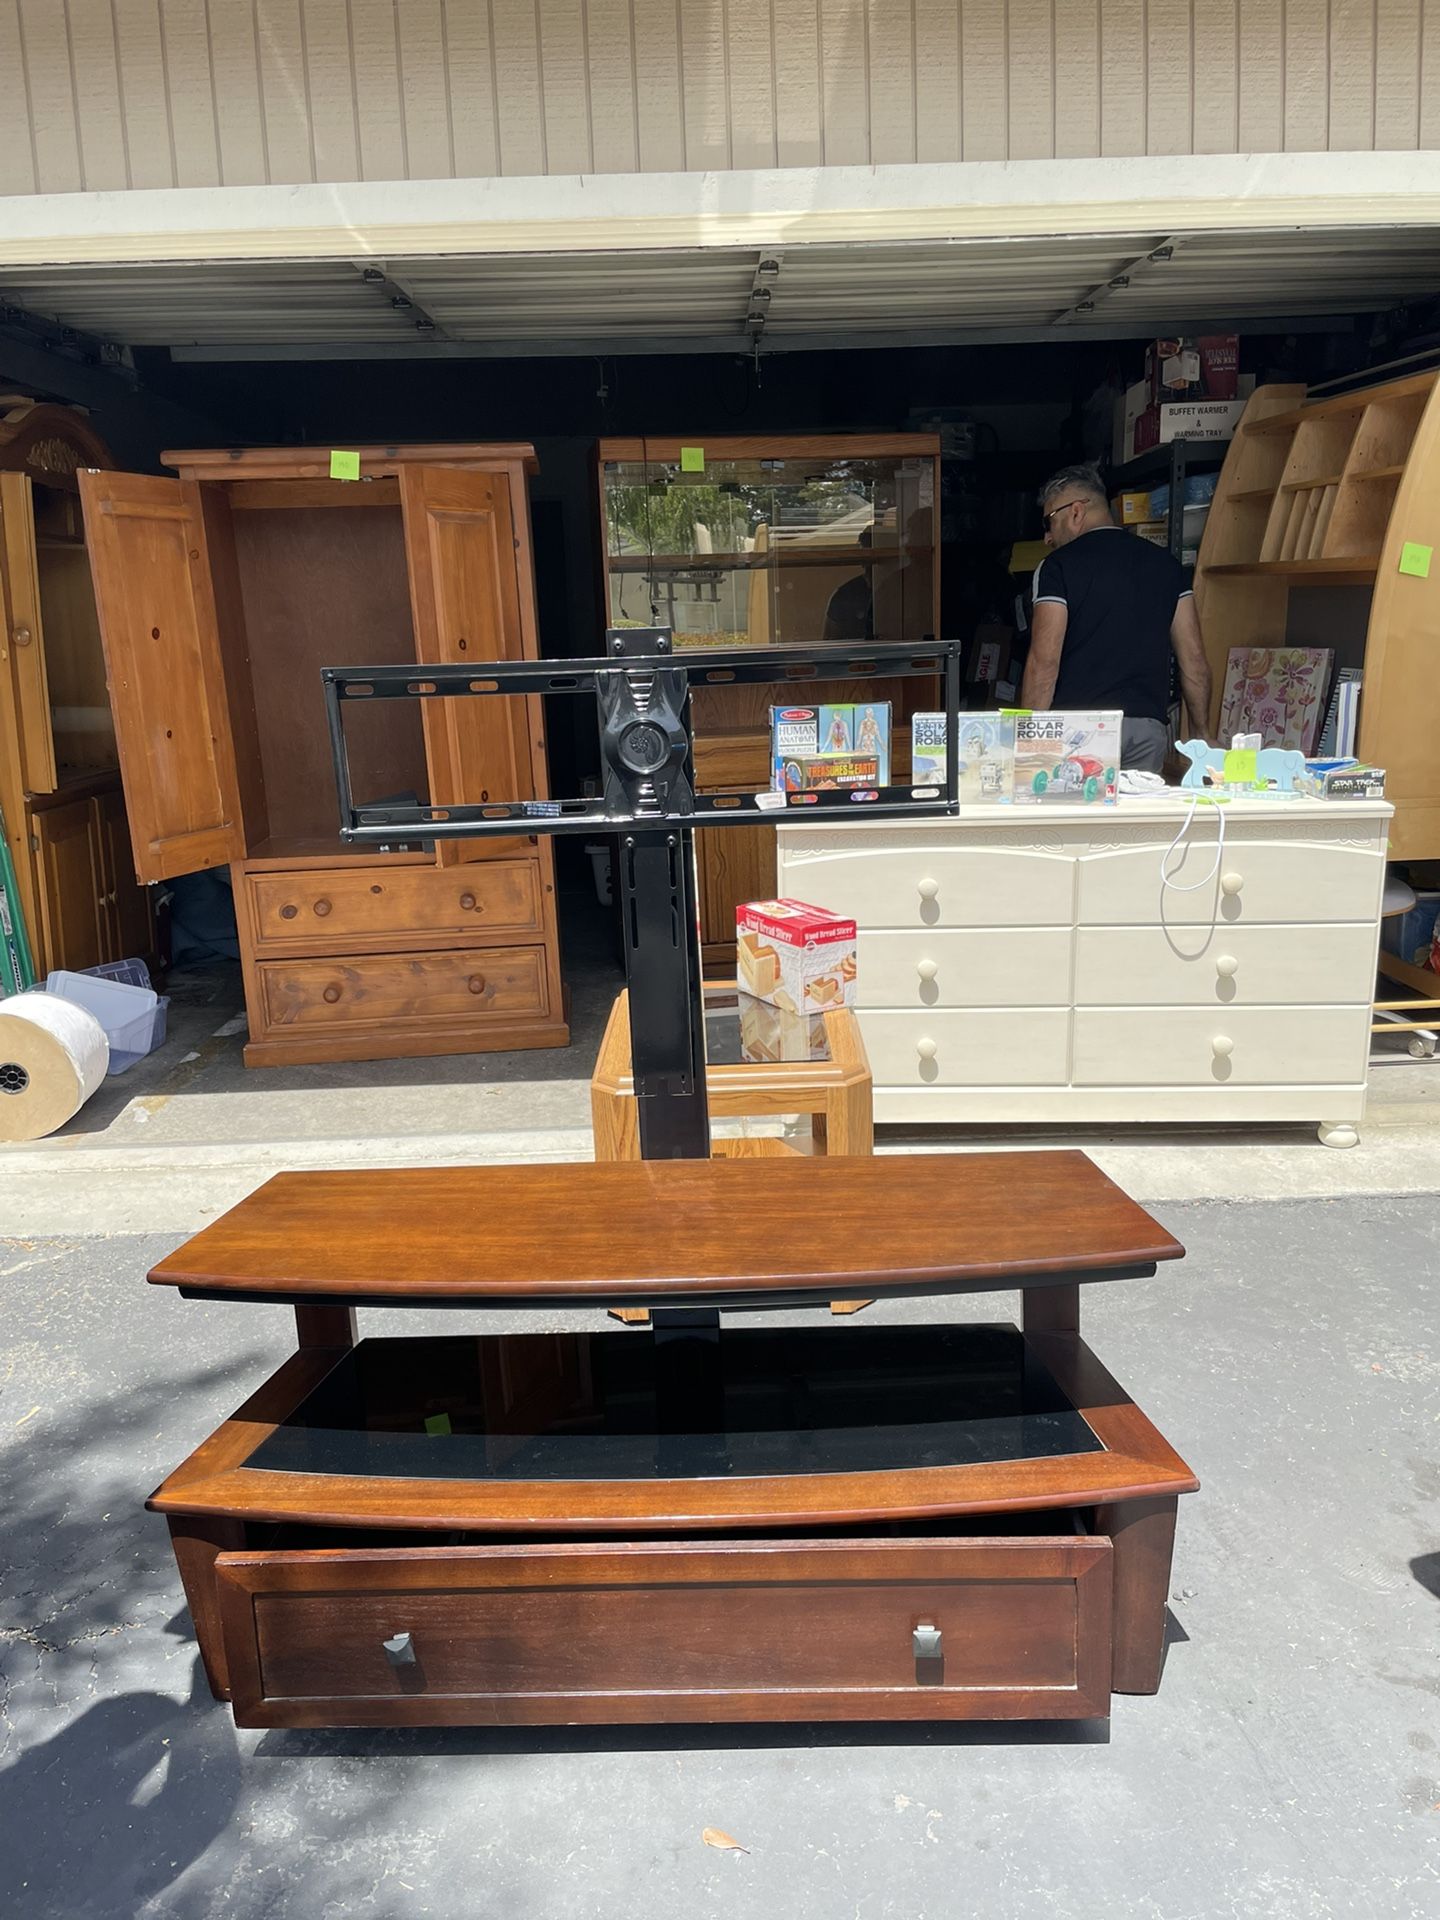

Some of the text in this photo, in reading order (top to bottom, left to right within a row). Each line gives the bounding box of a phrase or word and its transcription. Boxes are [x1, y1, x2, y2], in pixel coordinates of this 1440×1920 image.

[1169, 406, 1229, 416] BUFFET WARMER
[1174, 430, 1204, 438] WARMING
[978, 655, 991, 681] AGILE
[1017, 721, 1064, 730] SOLAR
[779, 725, 816, 736] HUMAN
[915, 729, 947, 738] SOLA
[1017, 730, 1063, 739] ROVER
[779, 735, 816, 744] ANATOMY
[915, 737, 947, 746] ROBO
[807, 764, 848, 778] TREASURES
[855, 762, 876, 775] EARTH
[759, 921, 776, 937] Bread
[775, 926, 793, 943] Slicer
[819, 928, 836, 939] Bread
[836, 926, 854, 936] Slicer
